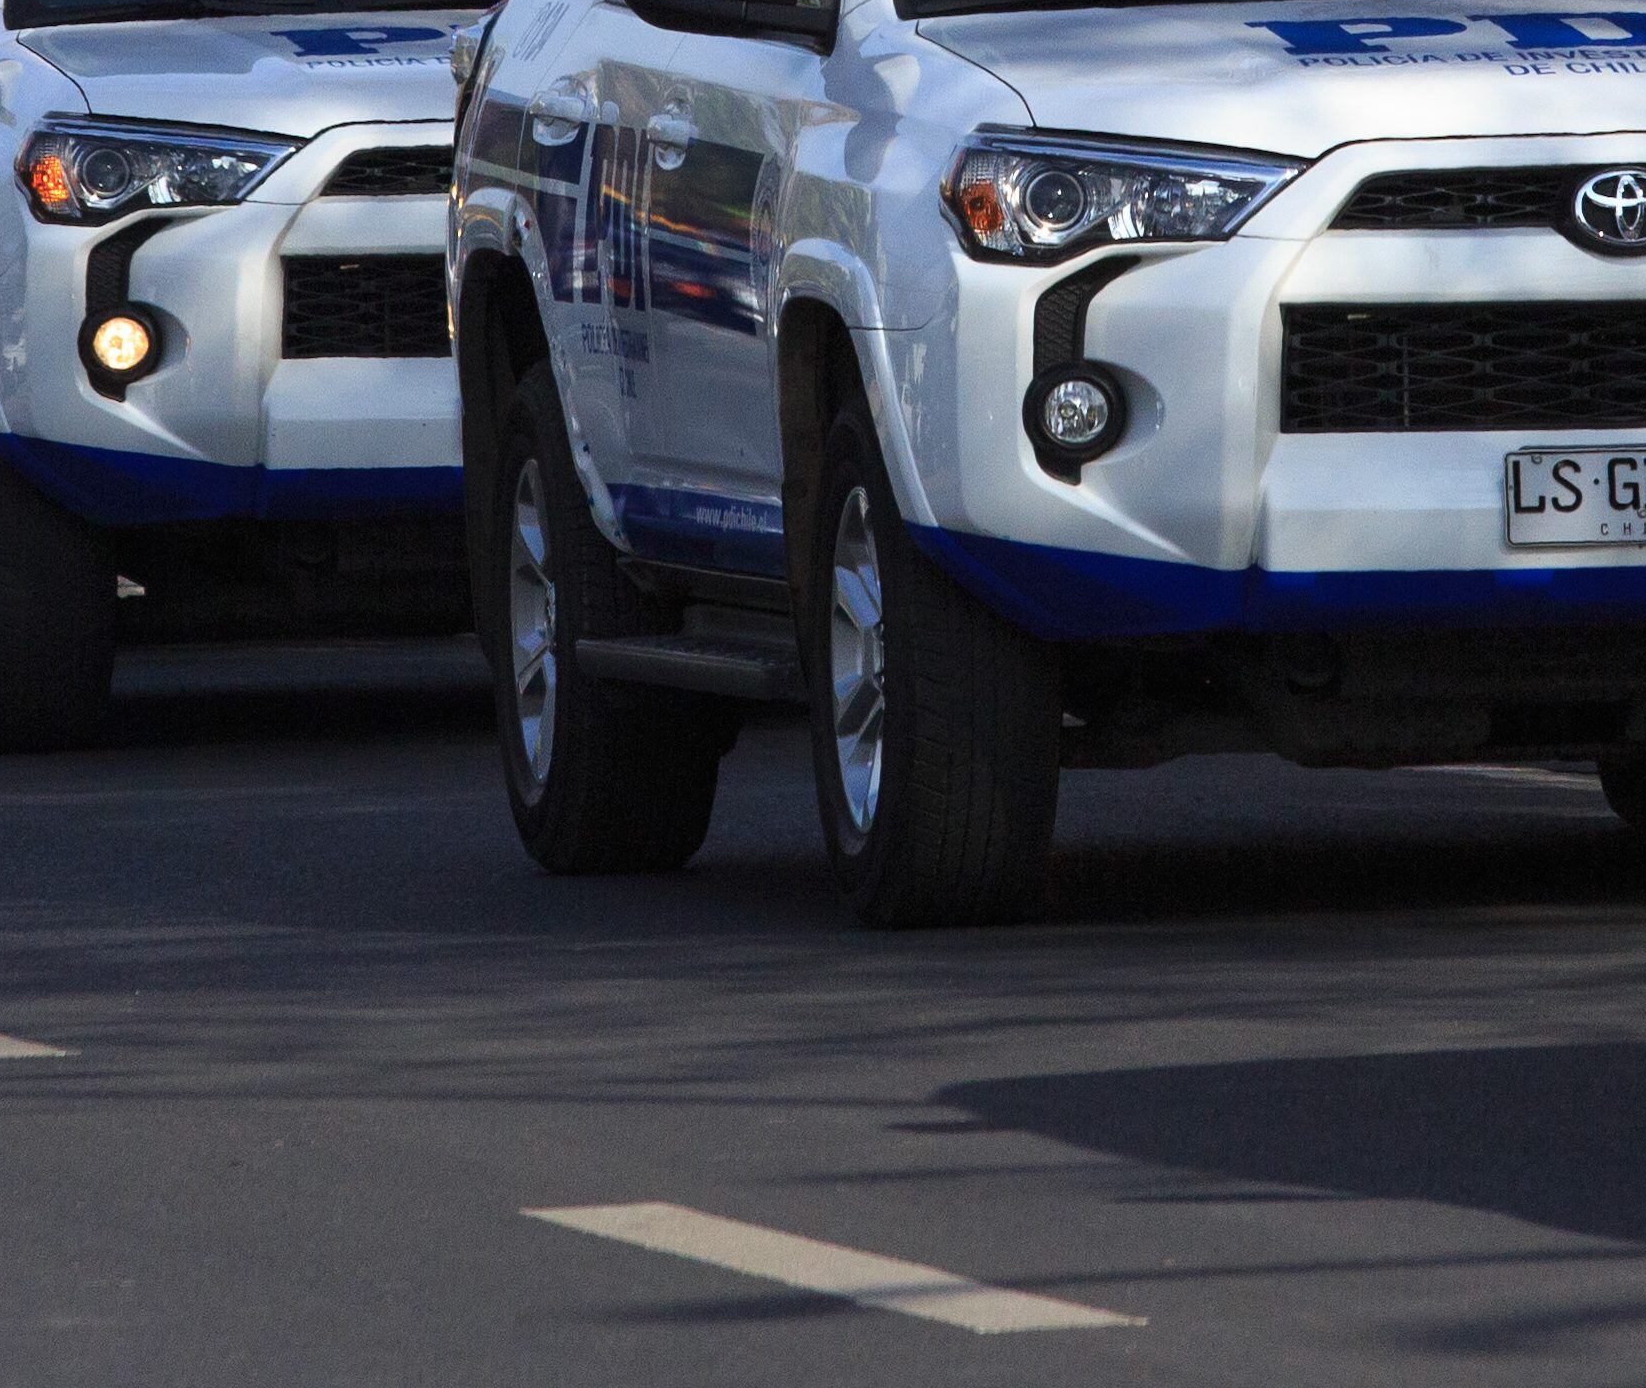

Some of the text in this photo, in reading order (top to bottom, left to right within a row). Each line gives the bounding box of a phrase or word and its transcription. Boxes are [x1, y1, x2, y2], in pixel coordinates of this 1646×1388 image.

[1298, 52, 1442, 68] POLICÍA
[1456, 50, 1505, 63] DE
[1505, 63, 1556, 77] DE
